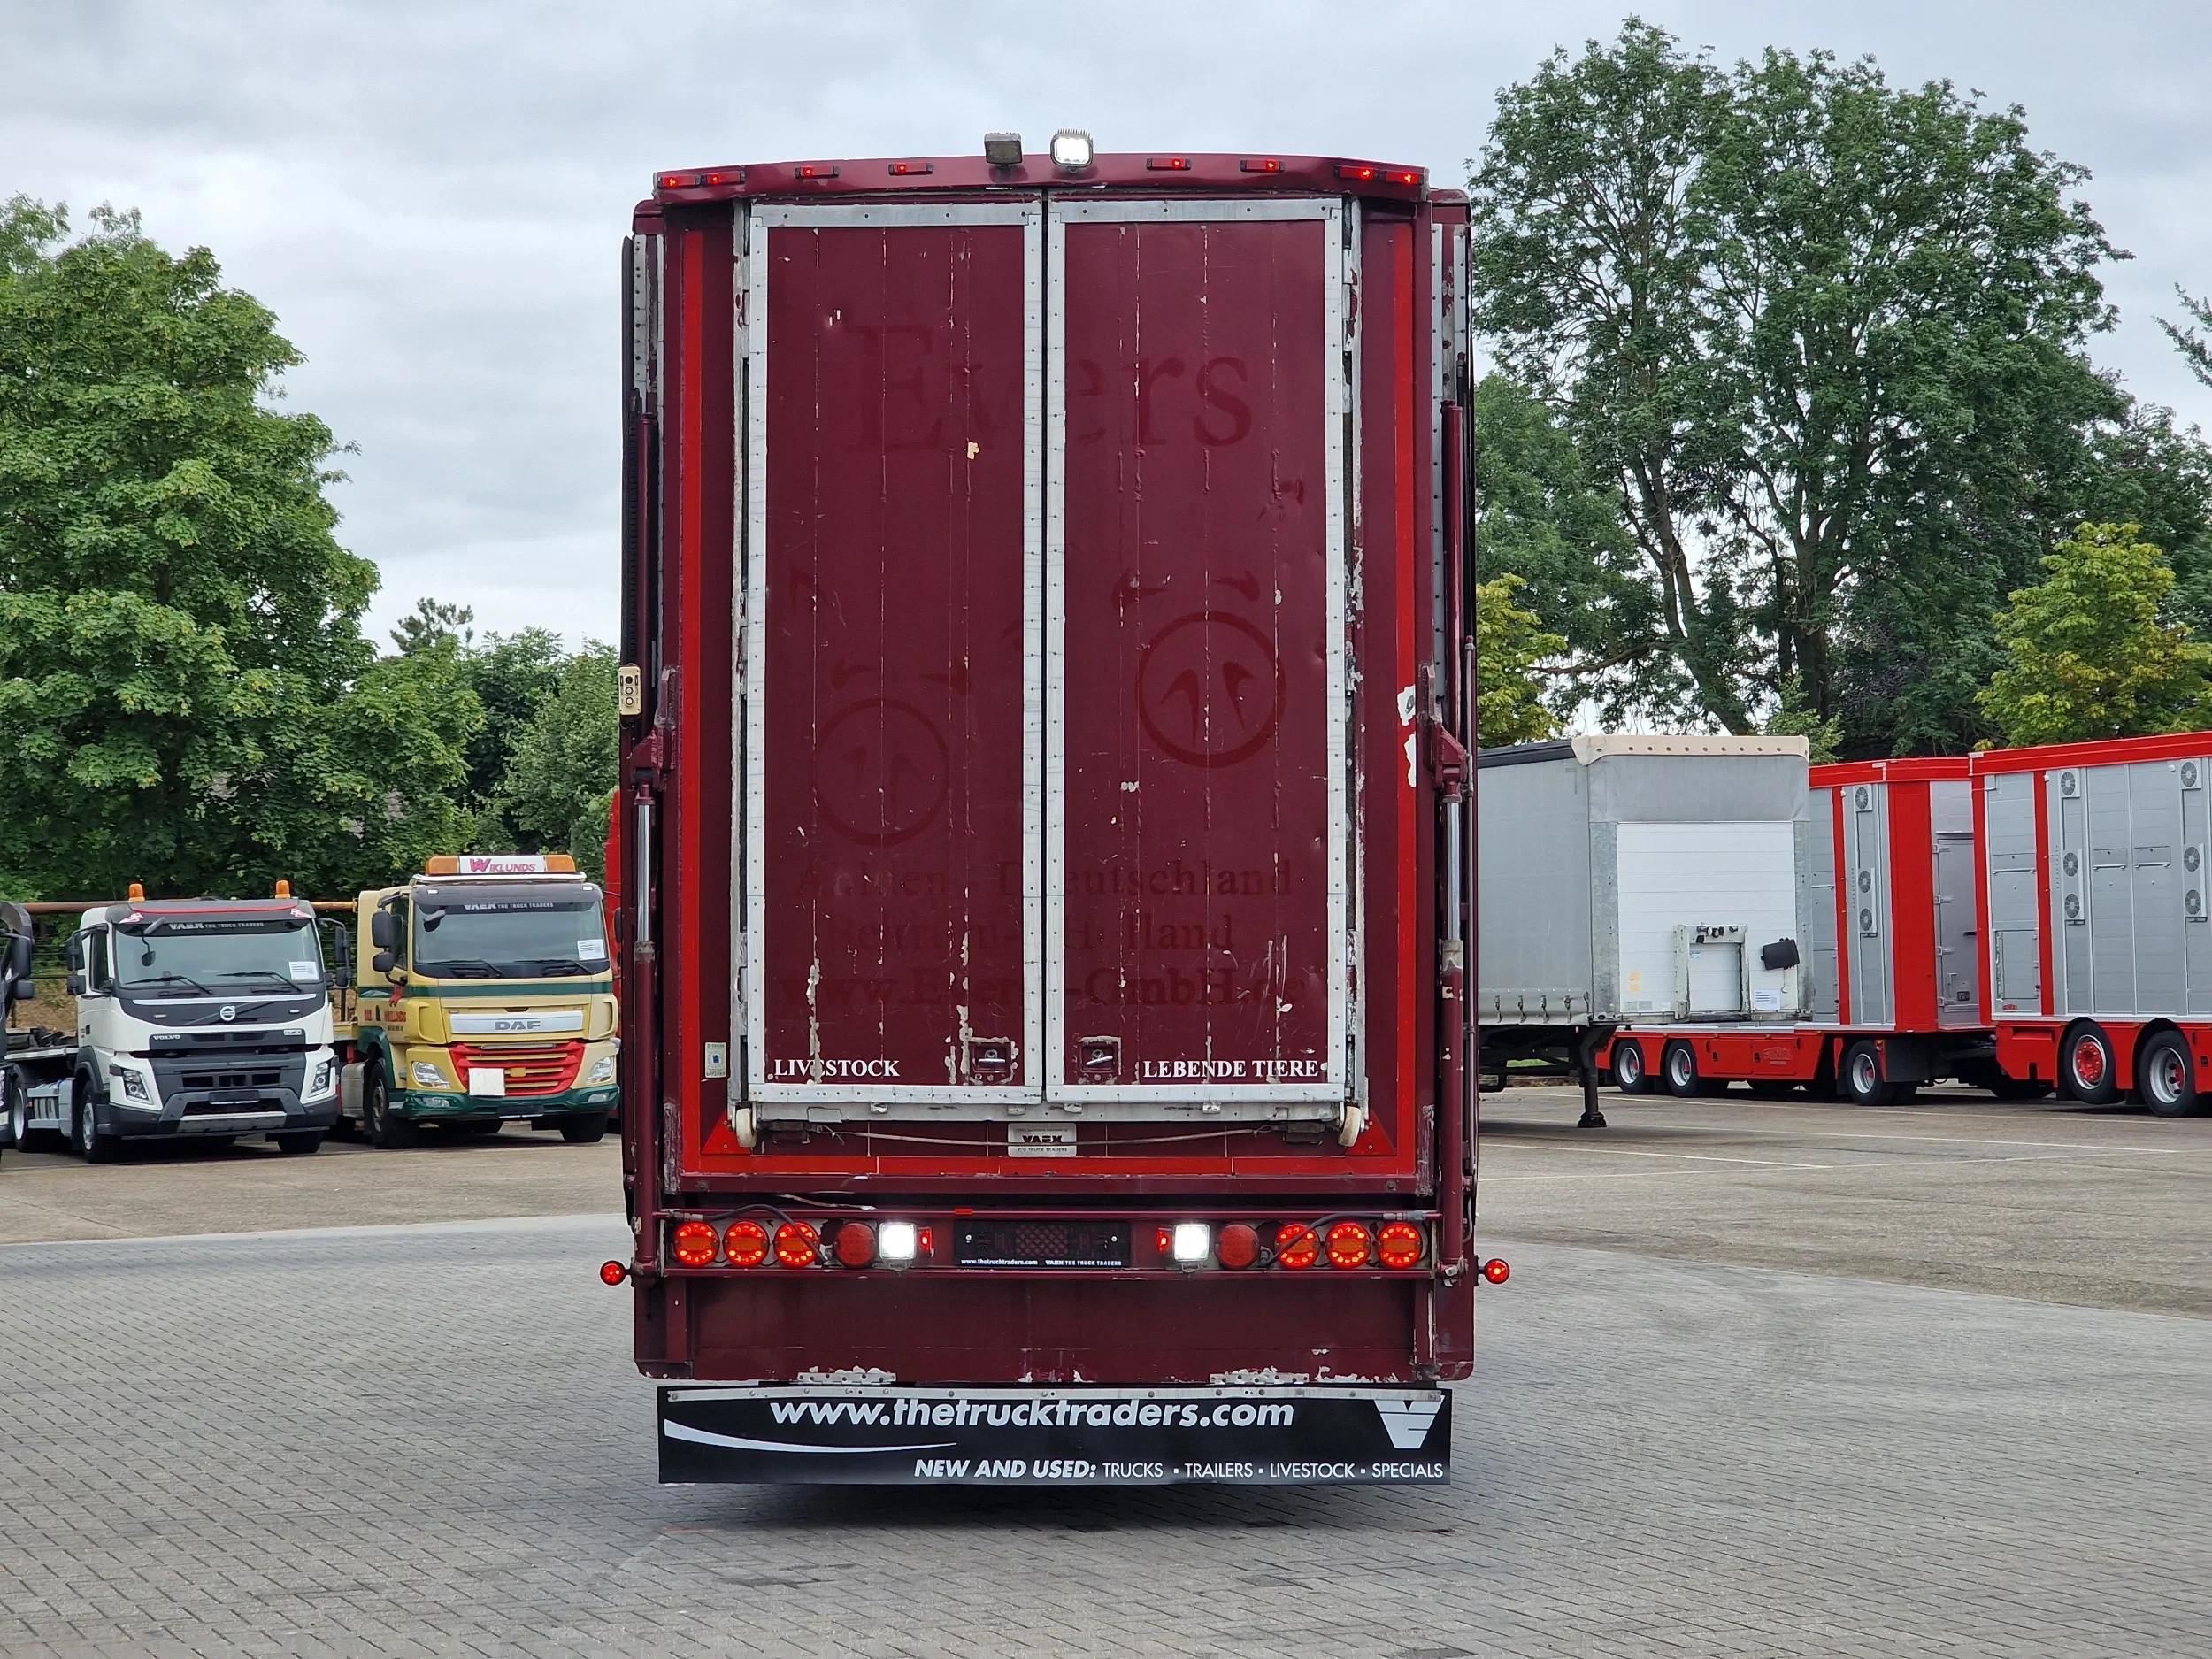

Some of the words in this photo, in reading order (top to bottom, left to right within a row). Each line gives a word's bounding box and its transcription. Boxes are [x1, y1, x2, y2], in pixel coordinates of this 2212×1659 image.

[469, 858, 535, 872] WIKLUNDS
[495, 1020, 541, 1030] DAF
[1143, 1060, 1247, 1078] LEBENDE
[1252, 1060, 1318, 1078] TIERE
[770, 1398, 1294, 1426] www.thetrucktraders.com
[914, 1459, 970, 1478] NEW
[974, 1459, 1027, 1478] AND
[1033, 1459, 1096, 1478] USED:
[1102, 1463, 1164, 1478] TRUCKS
[1184, 1463, 1253, 1478] TRAILERS
[1270, 1463, 1355, 1478] LIVESTOCK
[1371, 1463, 1443, 1478] SPECIALS
